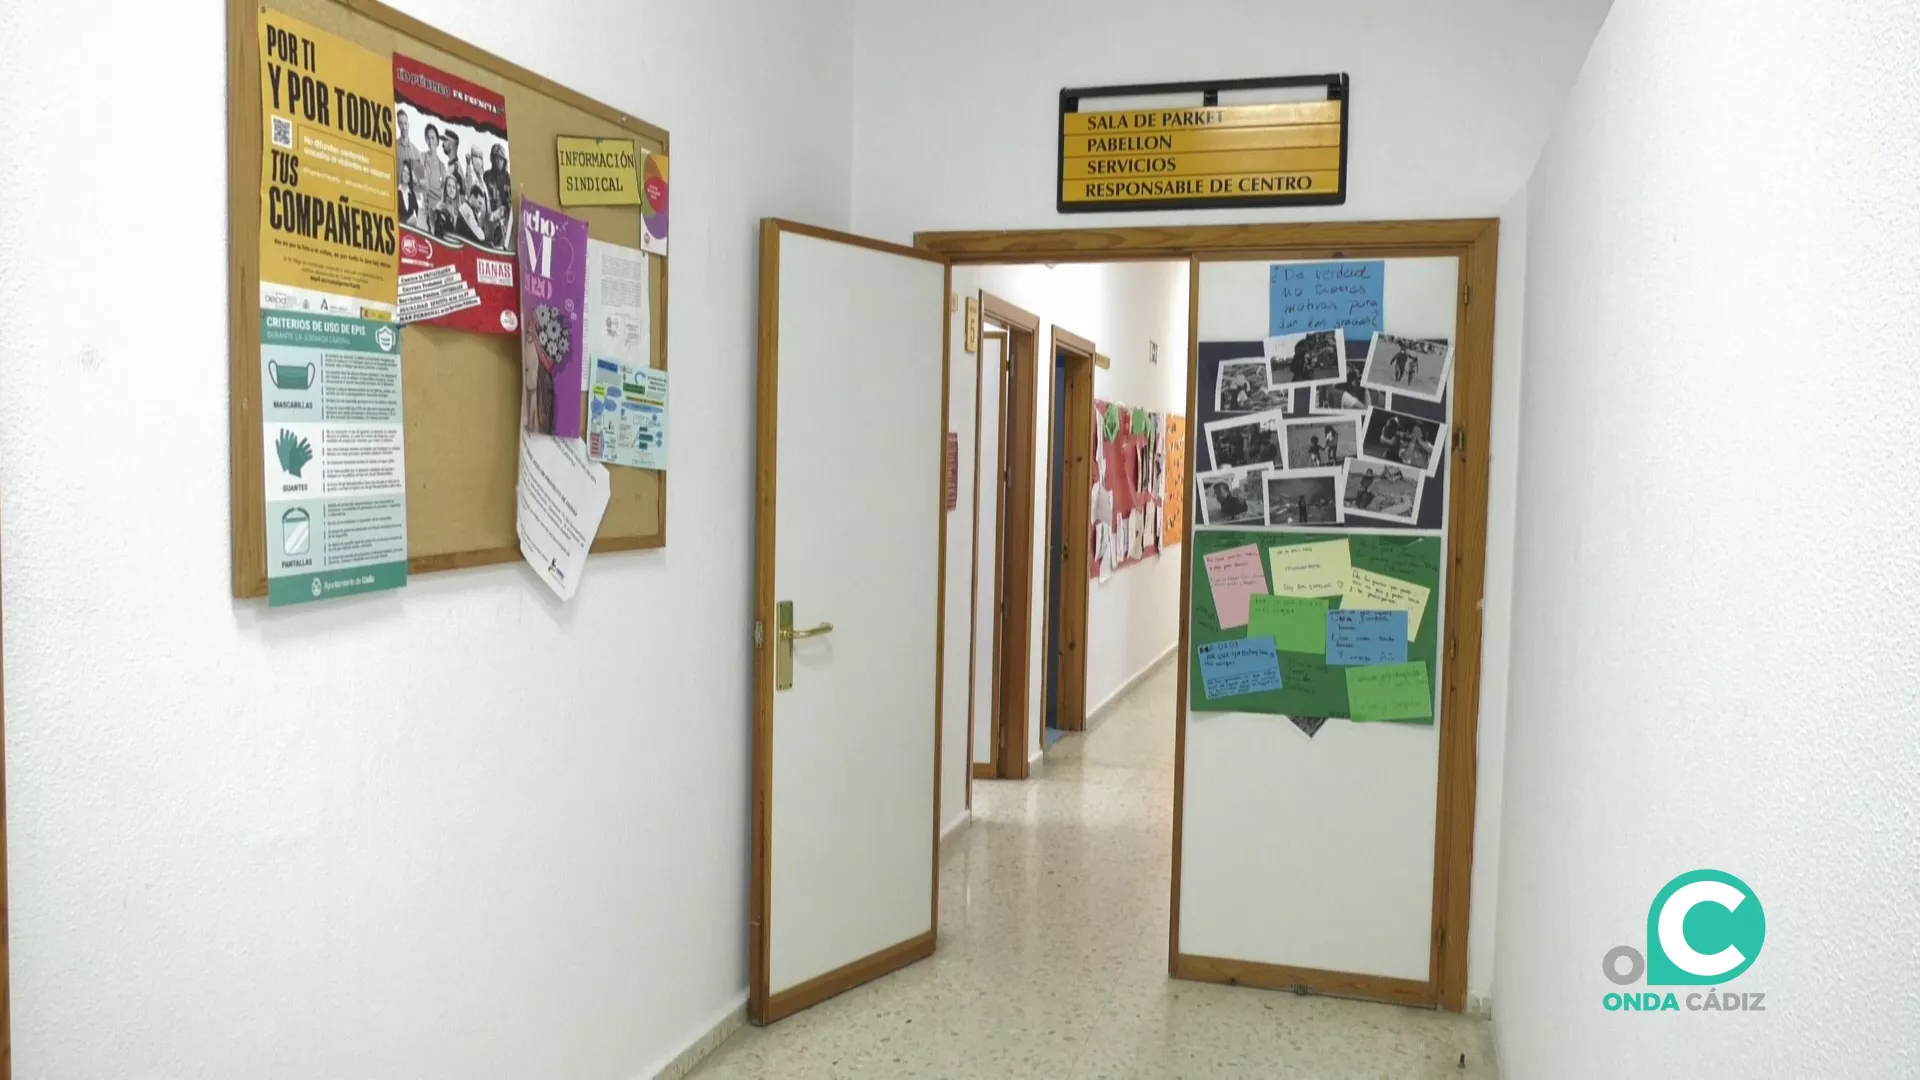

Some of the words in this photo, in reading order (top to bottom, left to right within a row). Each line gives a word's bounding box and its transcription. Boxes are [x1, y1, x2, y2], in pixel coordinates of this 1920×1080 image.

[267, 24, 298, 67] POR
[302, 37, 316, 74] TI
[267, 61, 281, 110] Y
[287, 68, 330, 127] POR
[333, 86, 393, 148] TODXS
[1087, 115, 1128, 131] SALA
[1134, 113, 1156, 128] DE
[1162, 110, 1224, 127] PARKET
[1087, 135, 1172, 152] PABELLON
[271, 148, 299, 187] TUS
[560, 150, 635, 169] INFORMACIÓN
[1087, 157, 1176, 174] SERVICIOS
[566, 176, 624, 192] SINDICAL
[1085, 179, 1204, 197] RESPONSABLE
[1210, 178, 1232, 193] DE
[1238, 175, 1312, 193] CENTRO
[269, 186, 395, 256] COMPAÑERXS
[266, 316, 310, 331] CRITERIOS
[312, 321, 322, 332] DE
[323, 322, 339, 333] USO
[341, 323, 350, 334] DE
[351, 325, 366, 336] EPIS
[273, 400, 313, 410] MASCARILLAS
[282, 484, 308, 493] GUANTES
[282, 558, 313, 569] PANTALLAS
